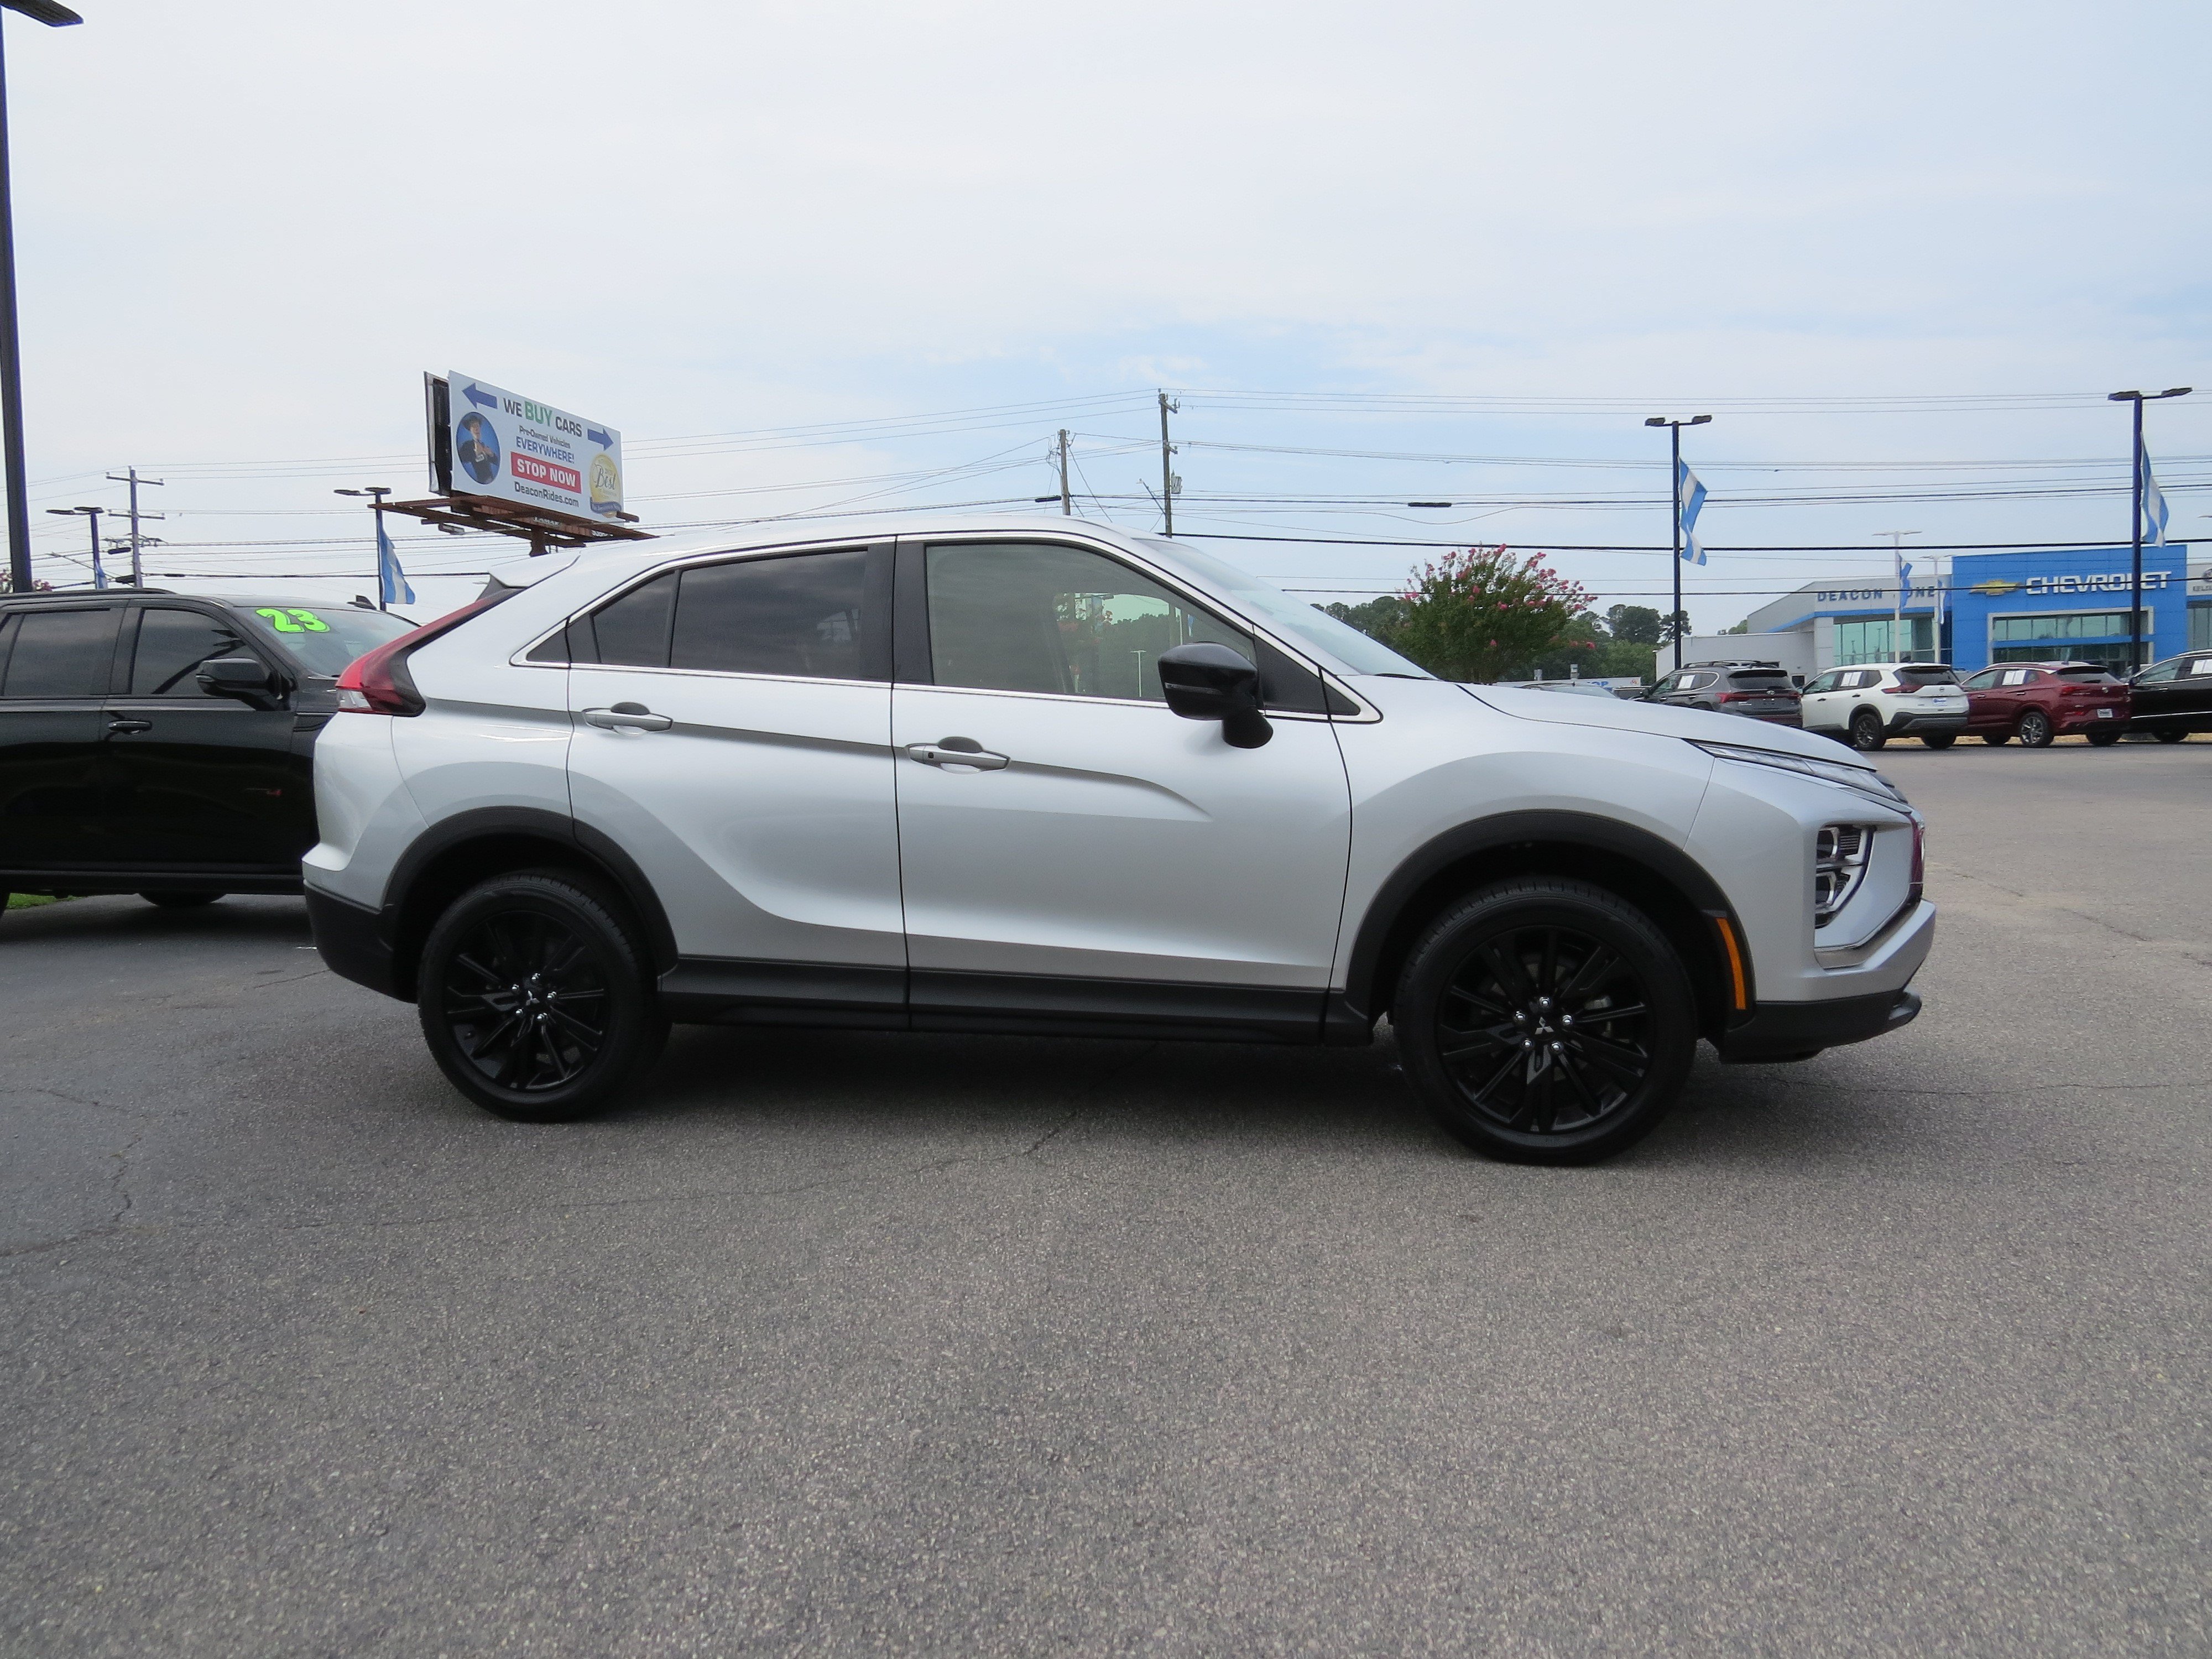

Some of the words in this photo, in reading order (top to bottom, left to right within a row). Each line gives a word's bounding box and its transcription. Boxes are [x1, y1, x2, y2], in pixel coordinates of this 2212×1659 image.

[503, 397, 523, 418] WE
[525, 400, 553, 427] BUY
[555, 416, 583, 437] CARS
[516, 436, 575, 464] EVERYWHERE!
[519, 425, 548, 442] Pre-Owned
[550, 435, 571, 449] Vehicles
[517, 459, 546, 479] STOP
[550, 469, 576, 487] NOW
[514, 481, 579, 508] DeaconRides.com
[1817, 588, 1882, 602] DEACON
[255, 608, 330, 633] 23
